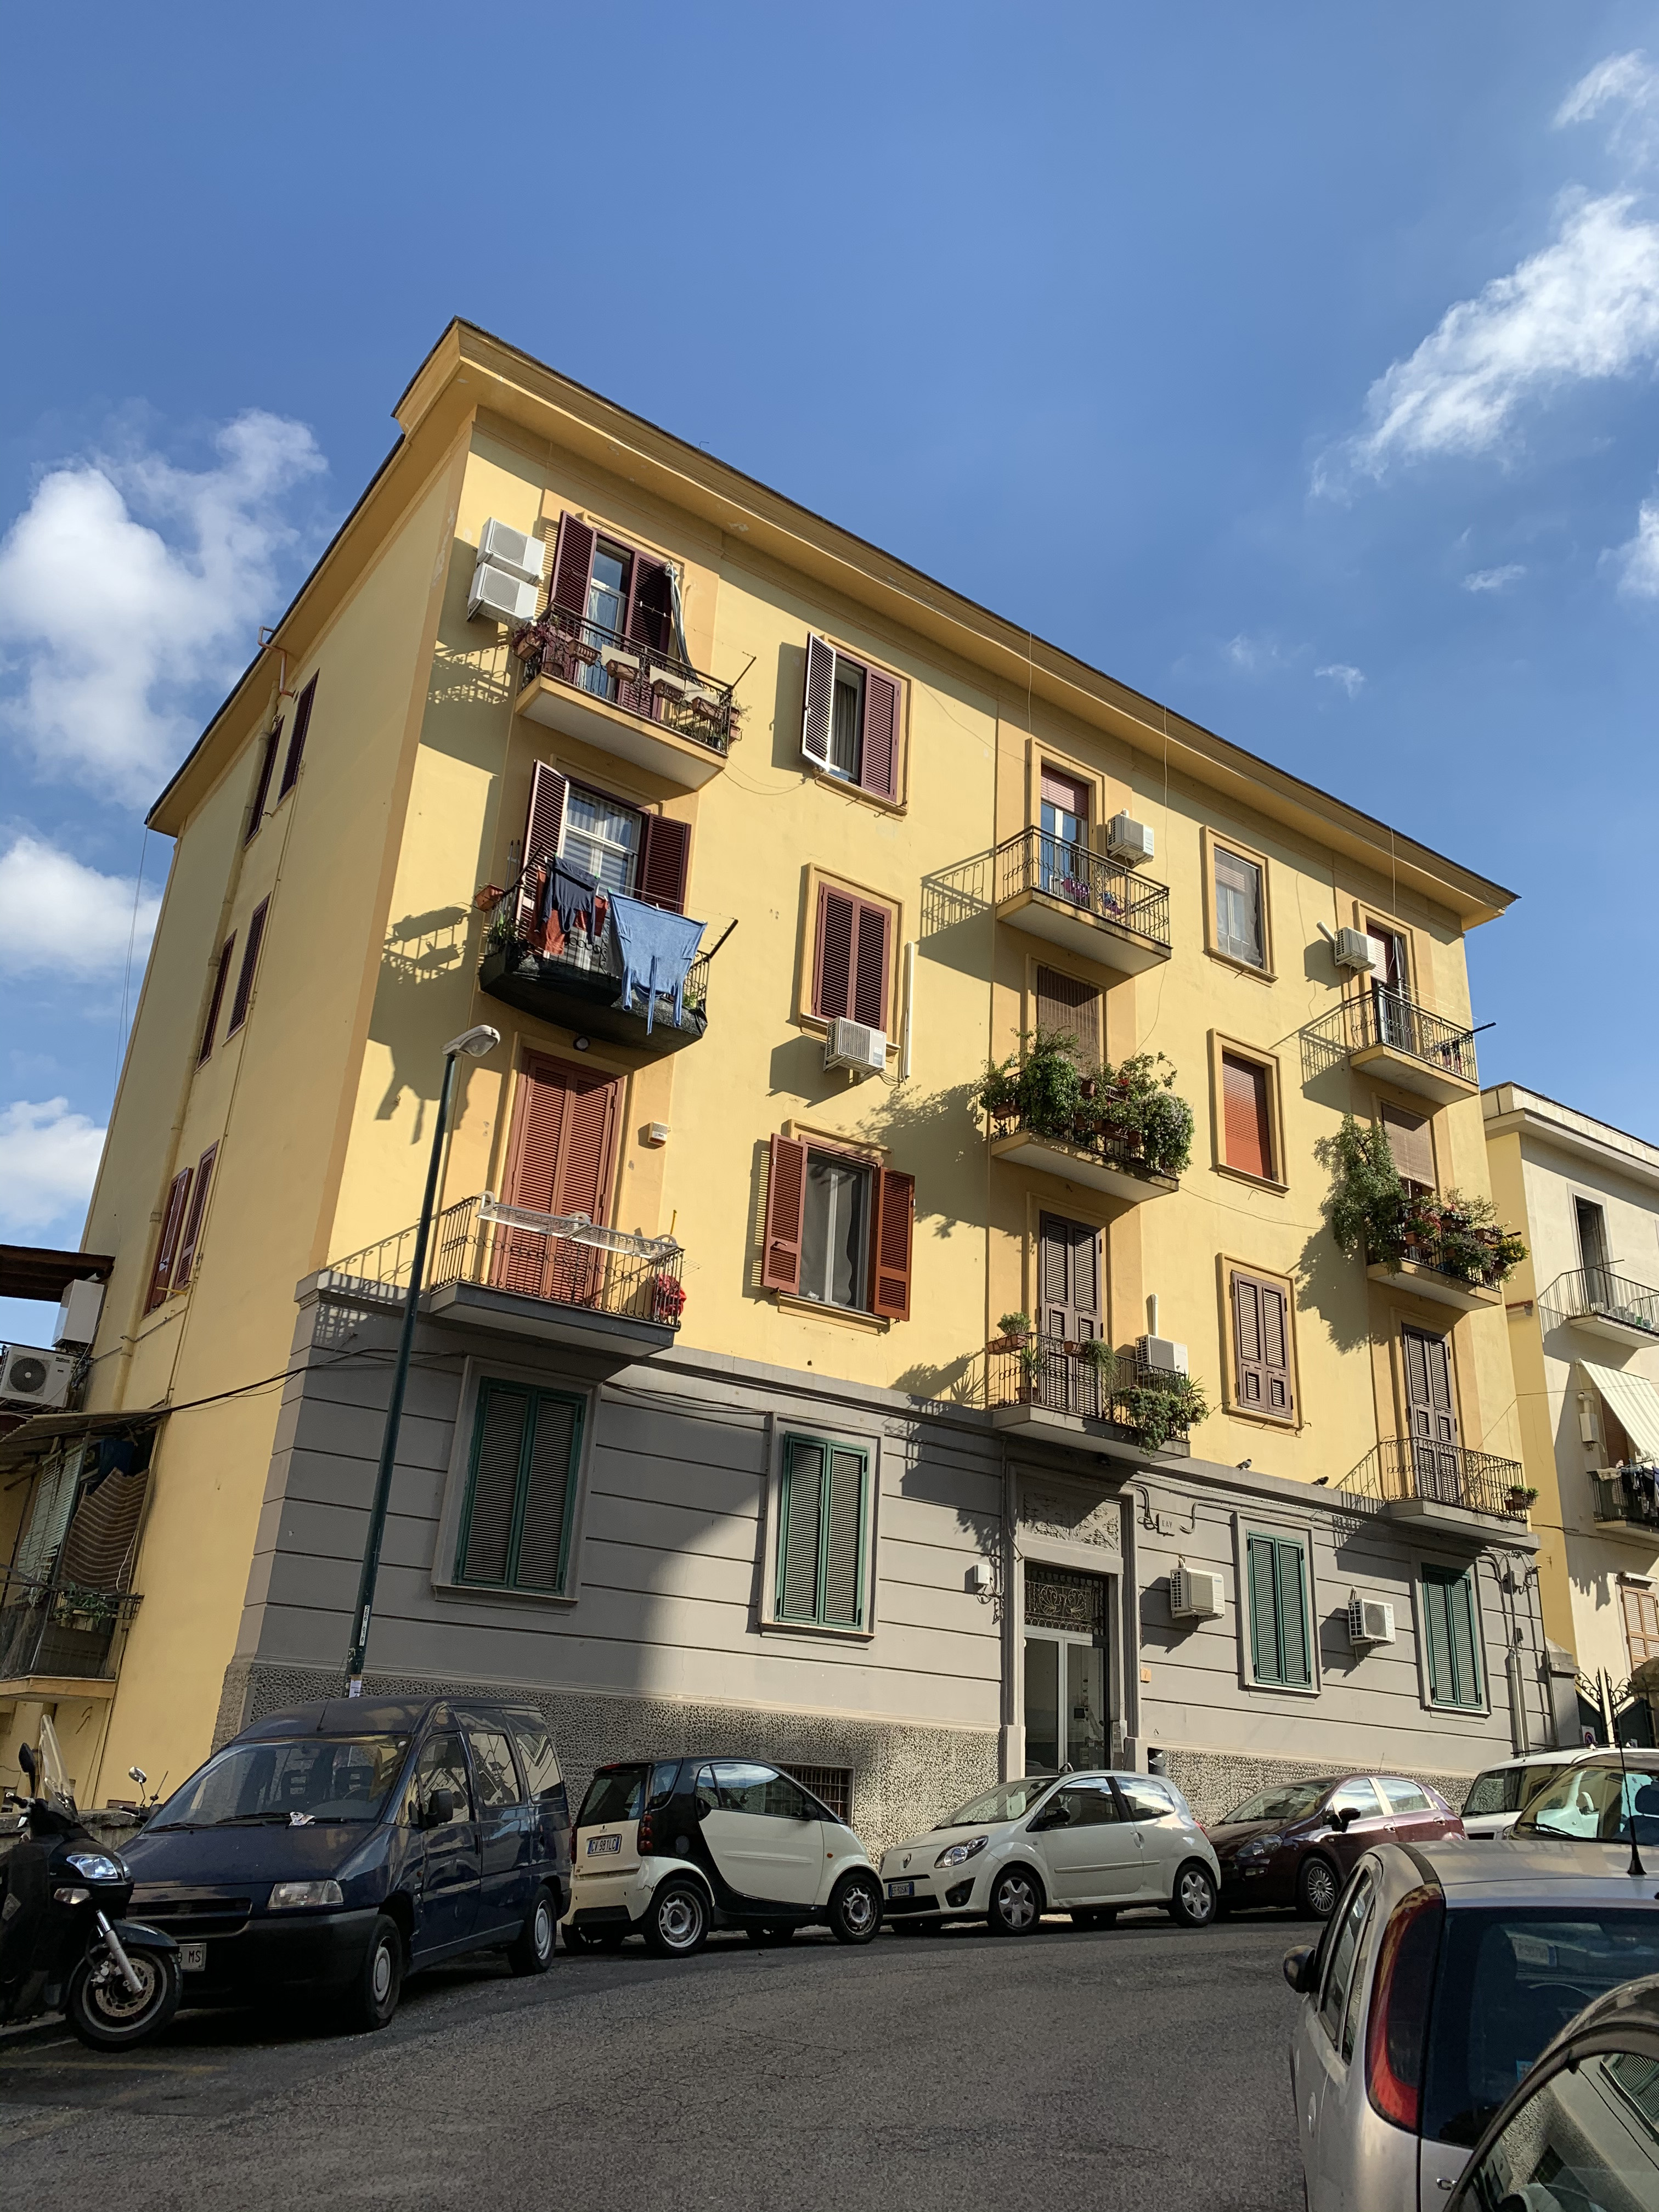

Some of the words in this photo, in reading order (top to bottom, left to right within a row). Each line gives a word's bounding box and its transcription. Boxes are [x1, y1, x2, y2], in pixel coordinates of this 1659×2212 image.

[1144, 1670, 1148, 1679] 7
[591, 1841, 599, 1852] CV
[177, 1951, 183, 1963] 9
[188, 1950, 201, 1963] MS
